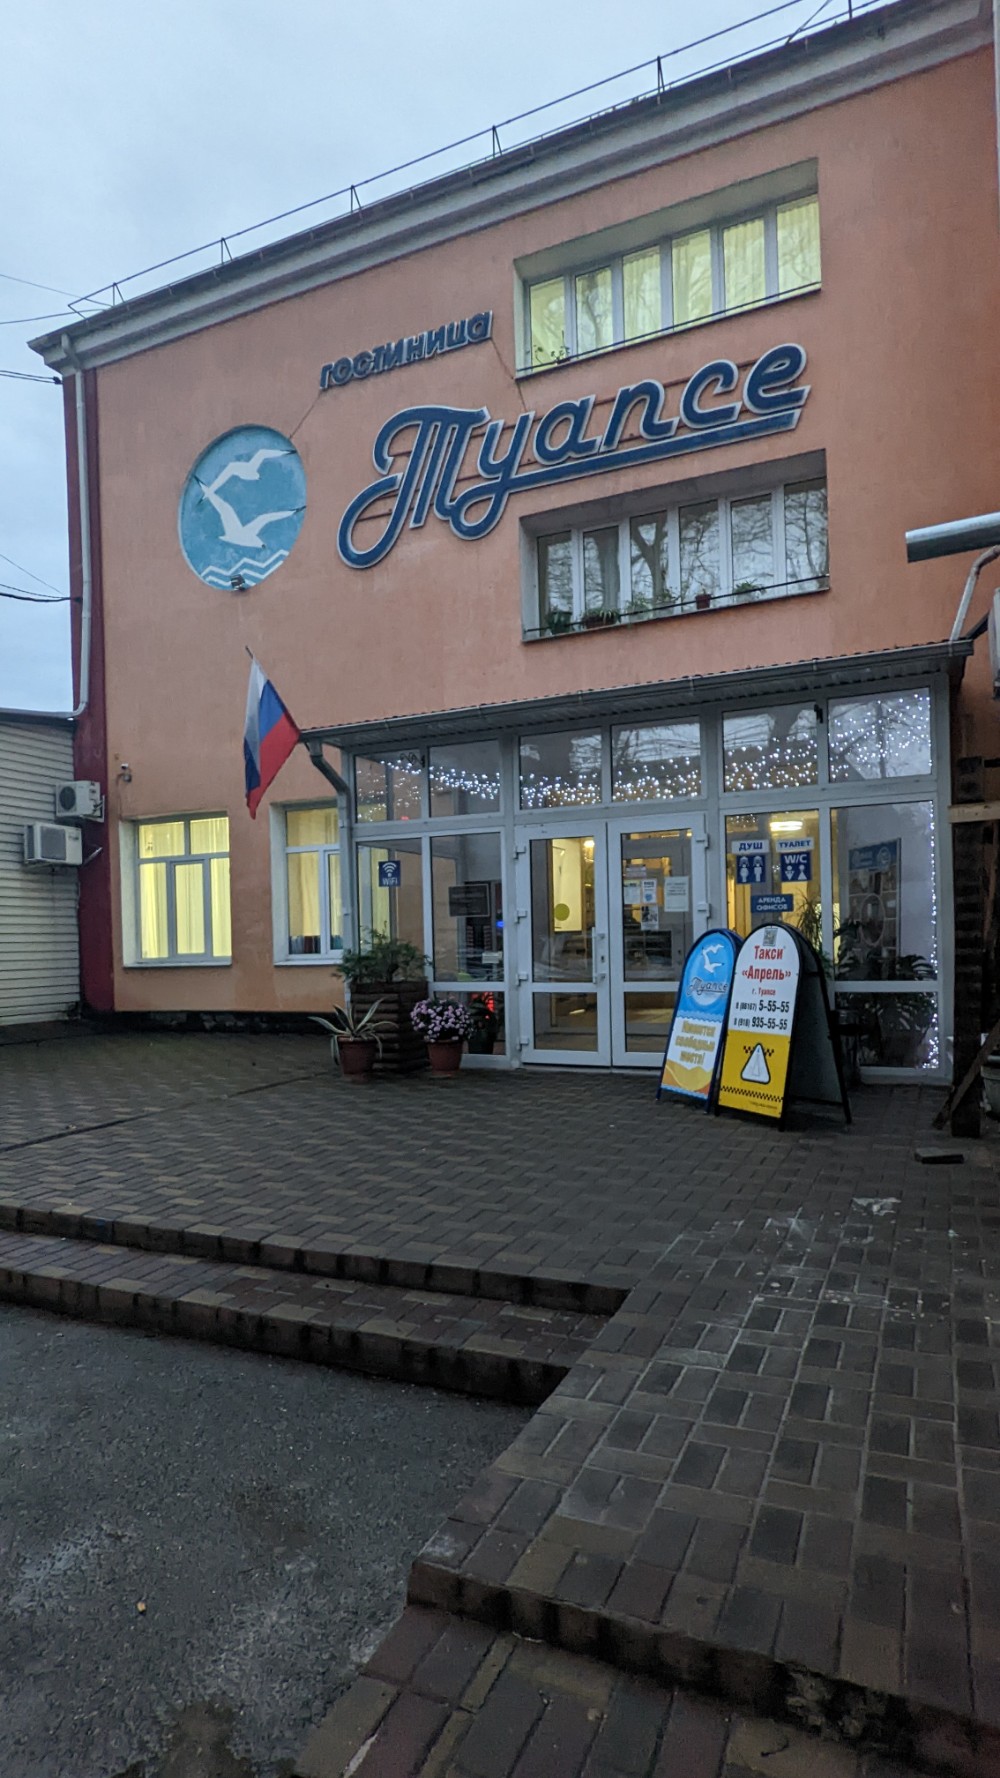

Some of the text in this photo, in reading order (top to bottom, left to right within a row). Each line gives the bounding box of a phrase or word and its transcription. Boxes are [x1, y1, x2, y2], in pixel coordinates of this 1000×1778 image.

[319, 310, 493, 390] гостиница
[337, 342, 811, 570] Туапсе
[739, 842, 763, 851] ДУШ
[779, 840, 811, 849] ТУАЛЕТ
[784, 854, 807, 864] W/C
[758, 896, 786, 904] АРЕНДА
[756, 903, 788, 911] ОФИСОВ
[754, 945, 784, 960] Такси
[742, 965, 791, 982] «Апрель»
[686, 976, 728, 995] Туапсе
[758, 987, 776, 996] Туапсе
[758, 1000, 790, 1013] 5-55-55
[751, 1017, 788, 1030] 935-55-55
